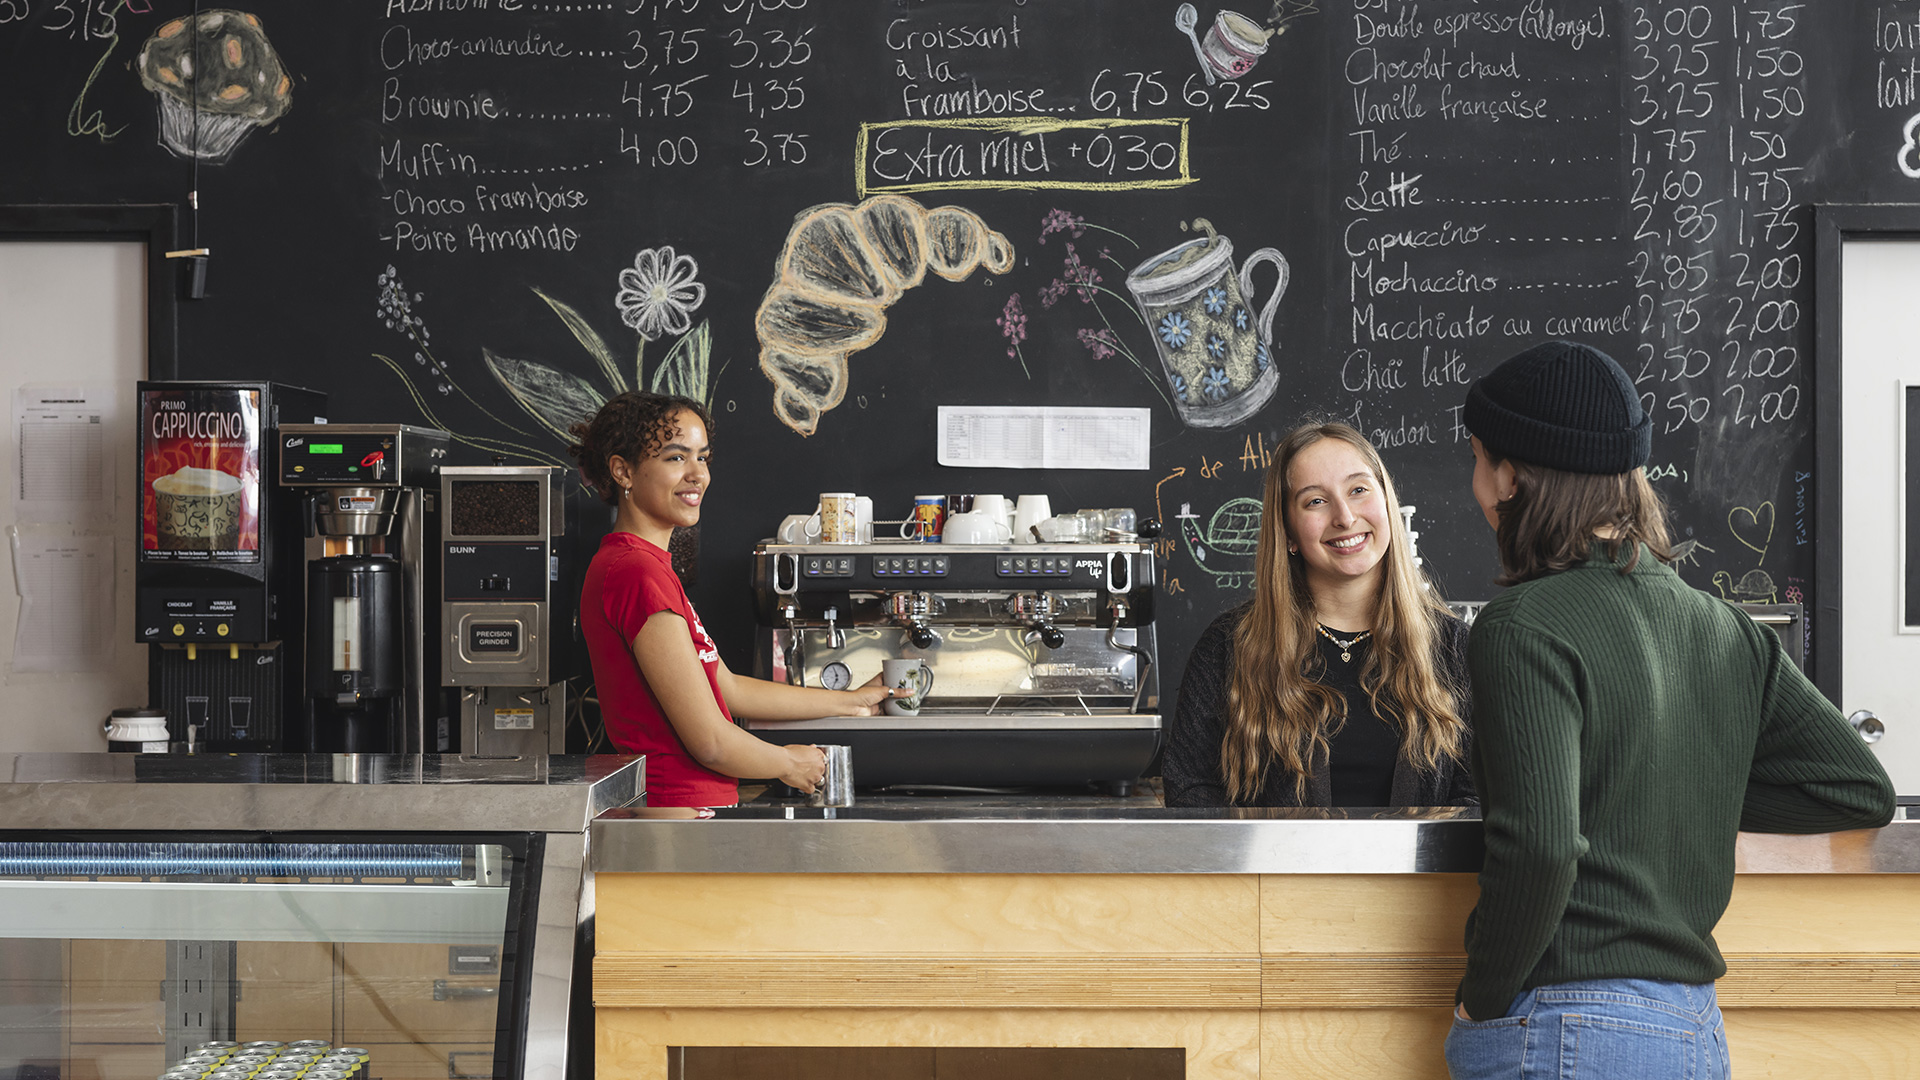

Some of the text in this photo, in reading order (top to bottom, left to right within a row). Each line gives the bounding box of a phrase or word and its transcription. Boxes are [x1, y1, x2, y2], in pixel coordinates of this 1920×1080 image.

[886, 15, 1022, 51] Croissant
[1354, 4, 1424, 46] Double
[1433, 11, 1519, 48] espresso
[1634, 6, 1712, 42] 3,00
[1732, 5, 1806, 44] 1,75
[380, 25, 816, 75] Choco-amandine 3,75 3,35
[896, 53, 957, 83] à la
[1344, 41, 1804, 85] Chocolat chaud 3,25 1,50
[381, 74, 806, 123] Brownie 4,75 4,35
[1090, 69, 1168, 117] 6,75
[1183, 73, 1275, 114] 6,25
[1353, 82, 1805, 127] Vanille française 3,25 1,50
[378, 127, 810, 181] Muffin 4,00 3,75
[873, 128, 972, 182] Extra
[1068, 133, 1177, 176] +0,30
[1349, 126, 1788, 165] Thé 1,75 1,50
[1345, 167, 1804, 213] Latte 2,60 1,75
[467, 221, 579, 253] Amande
[1344, 199, 1801, 263] Capuccino 2,85 1,75
[1351, 251, 1802, 303] Mochaccino 2,85 2,00
[1352, 294, 1801, 344] Macchiato au caramel 2,75 2,00
[1421, 345, 1471, 386] latte
[1634, 342, 1711, 385] 2,50
[1721, 340, 1798, 384] 2,00
[160, 400, 186, 411] PRIMO
[1722, 383, 1800, 430] 2,00
[1200, 455, 1224, 481] de
[449, 546, 476, 554] BUNN
[1075, 560, 1103, 568] APPIA
